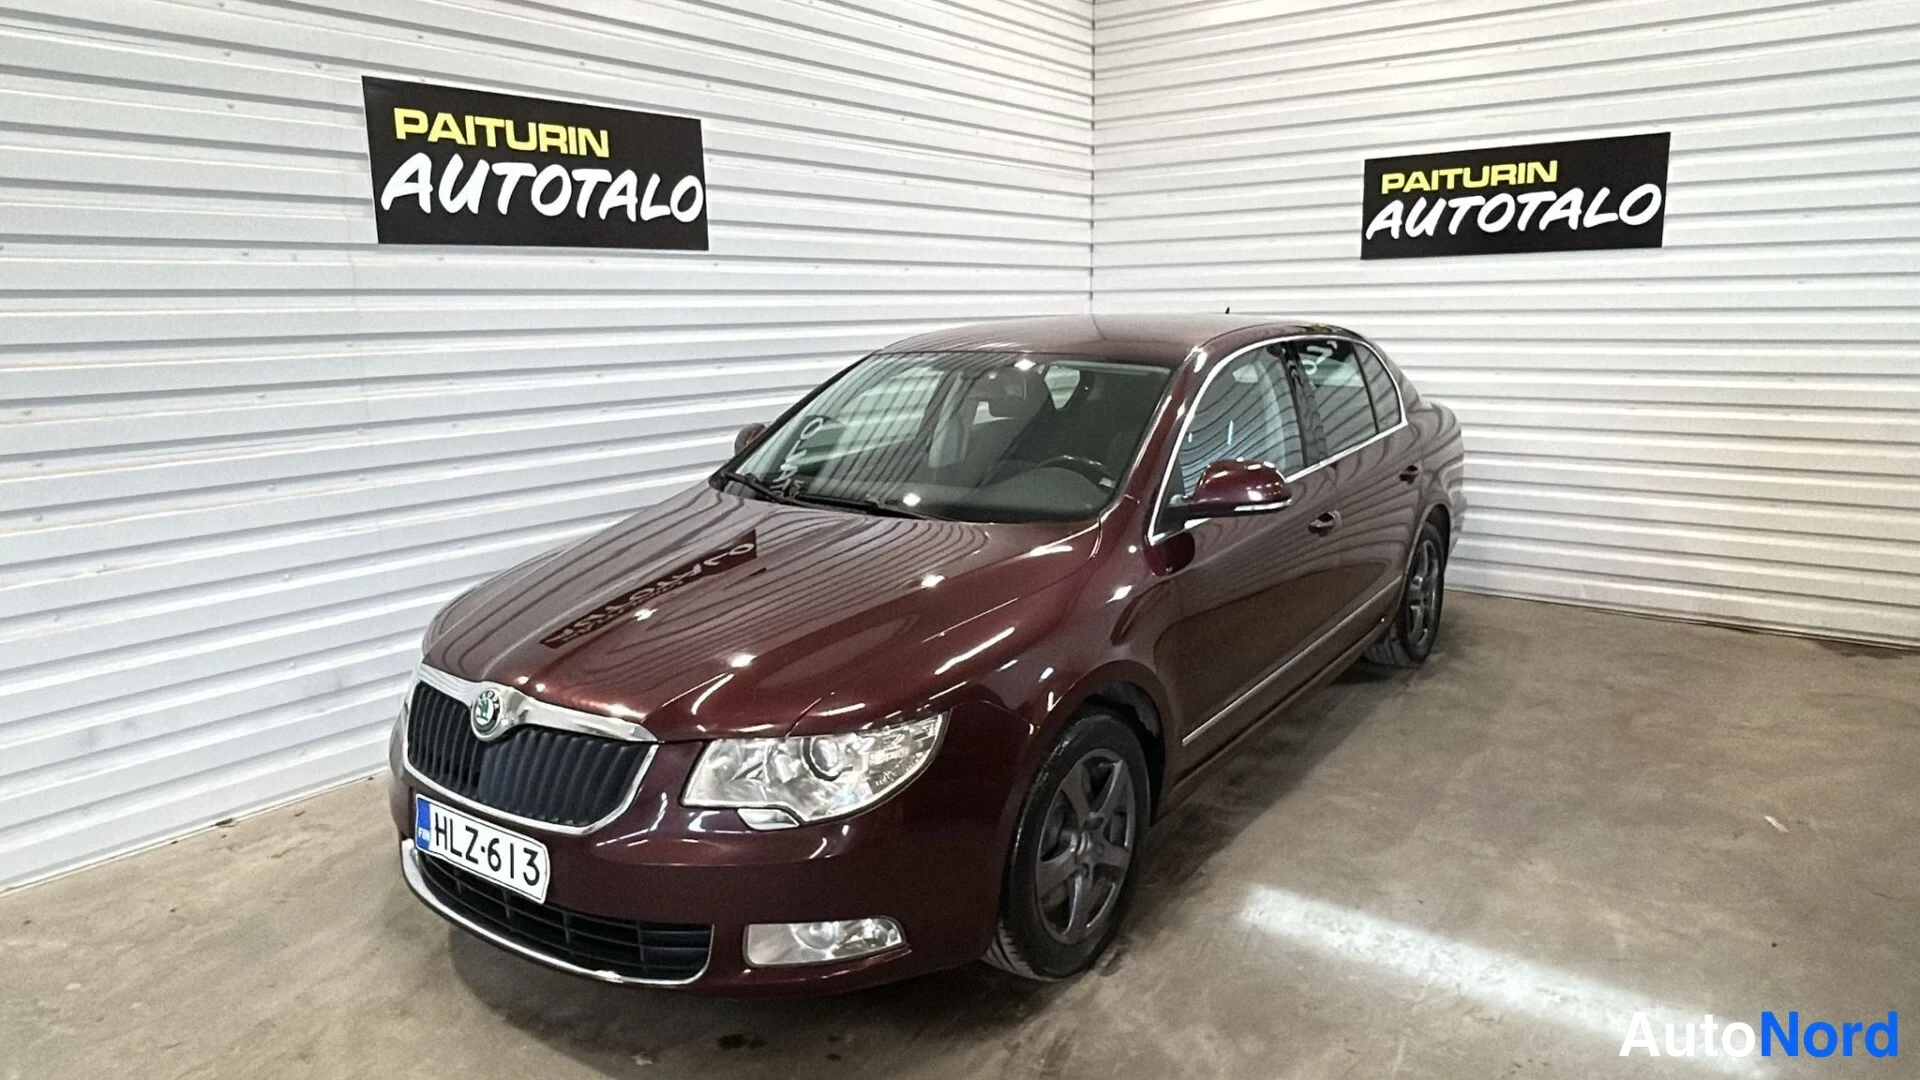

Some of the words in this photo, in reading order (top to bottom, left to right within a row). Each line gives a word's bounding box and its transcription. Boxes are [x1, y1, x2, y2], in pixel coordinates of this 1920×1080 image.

[394, 107, 610, 158] PAITURIN
[380, 152, 703, 223] AUTOTALO
[1381, 160, 1558, 194] PAITURIN
[1365, 183, 1662, 240] AUTOTALO
[435, 812, 540, 886] HLZ-613
